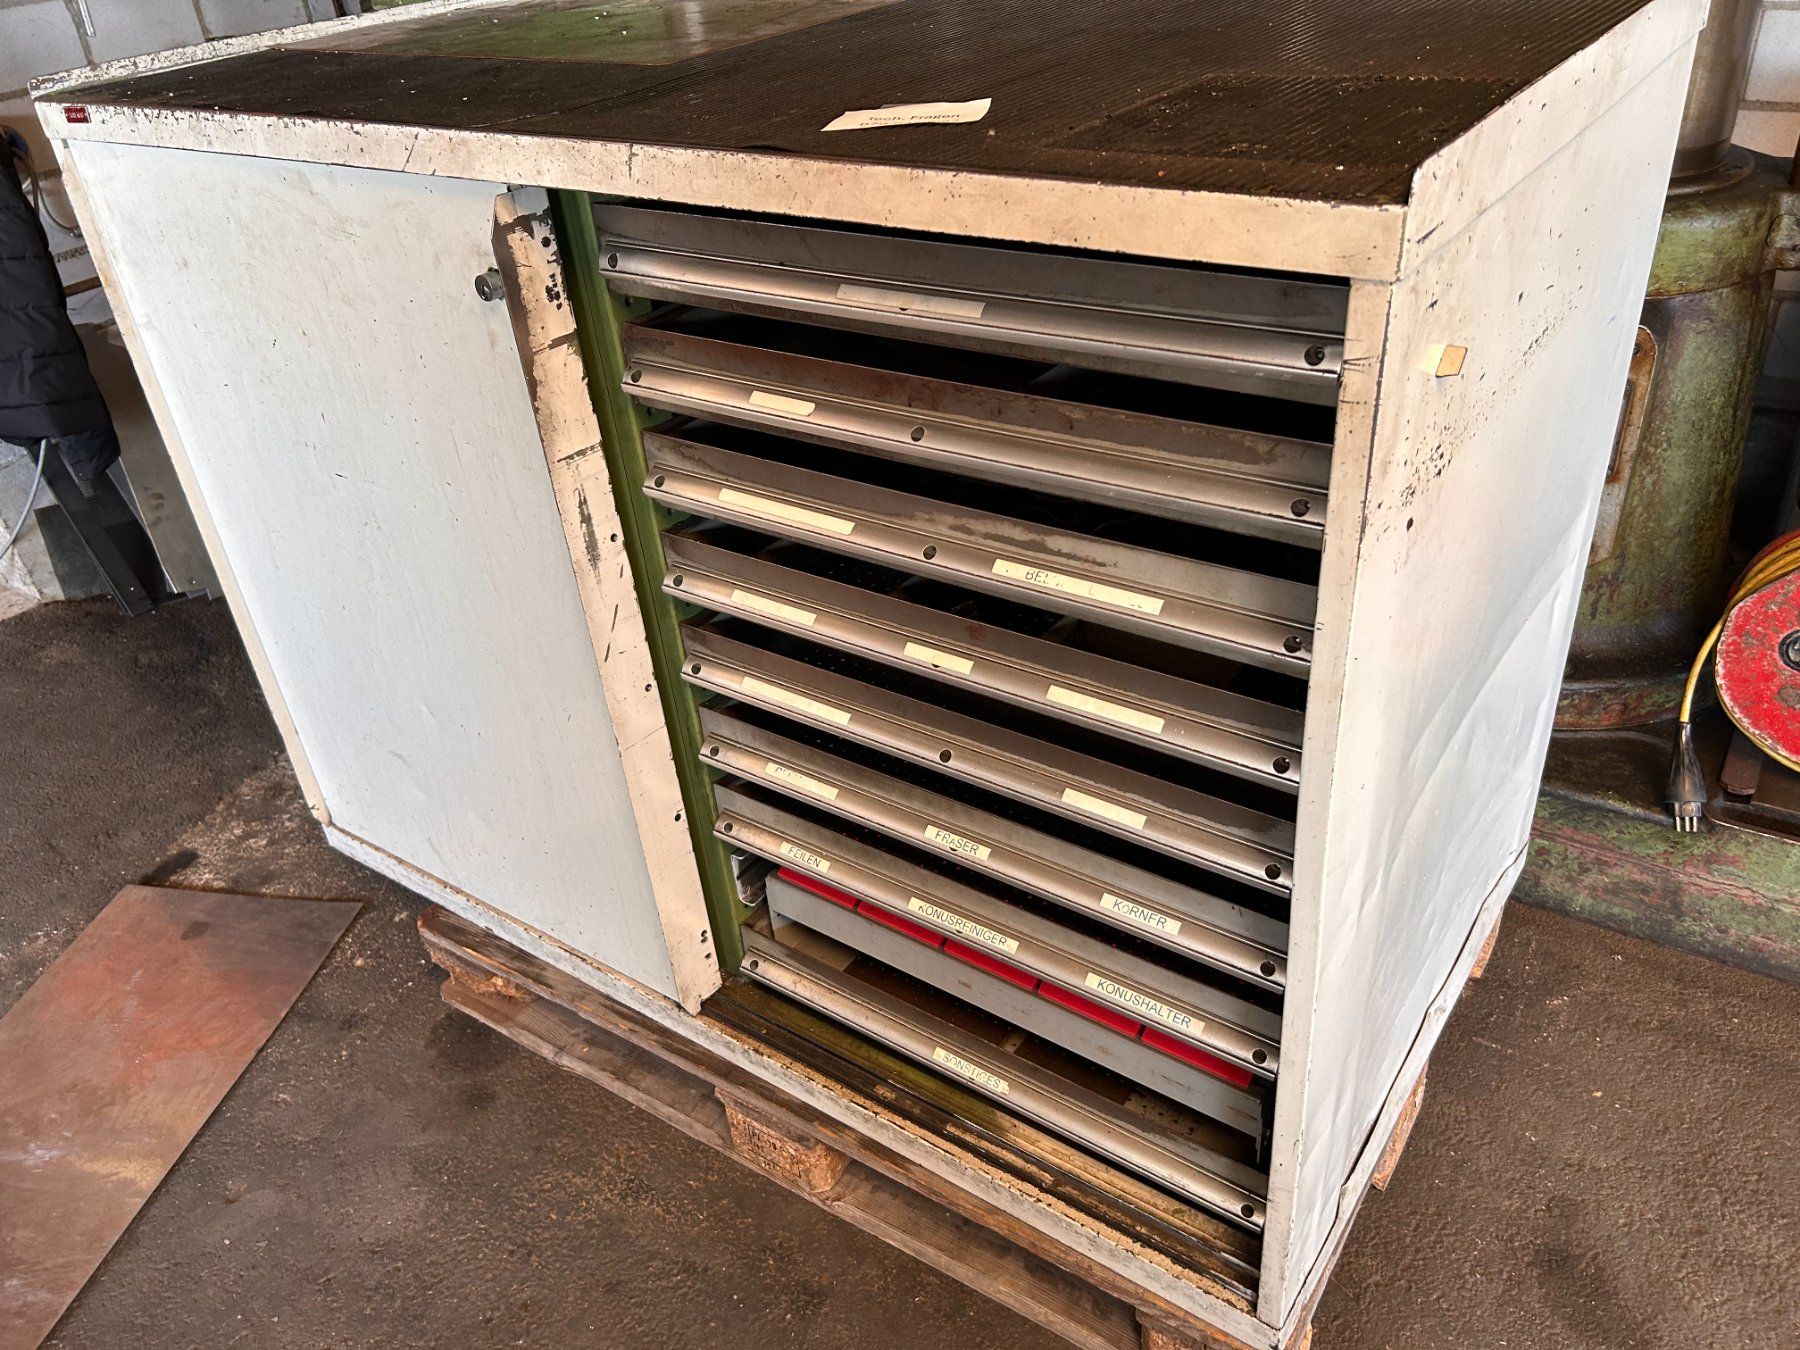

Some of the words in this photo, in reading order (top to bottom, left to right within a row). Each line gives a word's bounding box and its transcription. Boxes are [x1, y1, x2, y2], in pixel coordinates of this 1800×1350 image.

[788, 846, 822, 868] FEILEN
[917, 904, 1008, 947] KONUSREINIGER
[1096, 978, 1192, 1029] KONUSHALTER
[942, 1053, 1001, 1089] SONSTIGES
